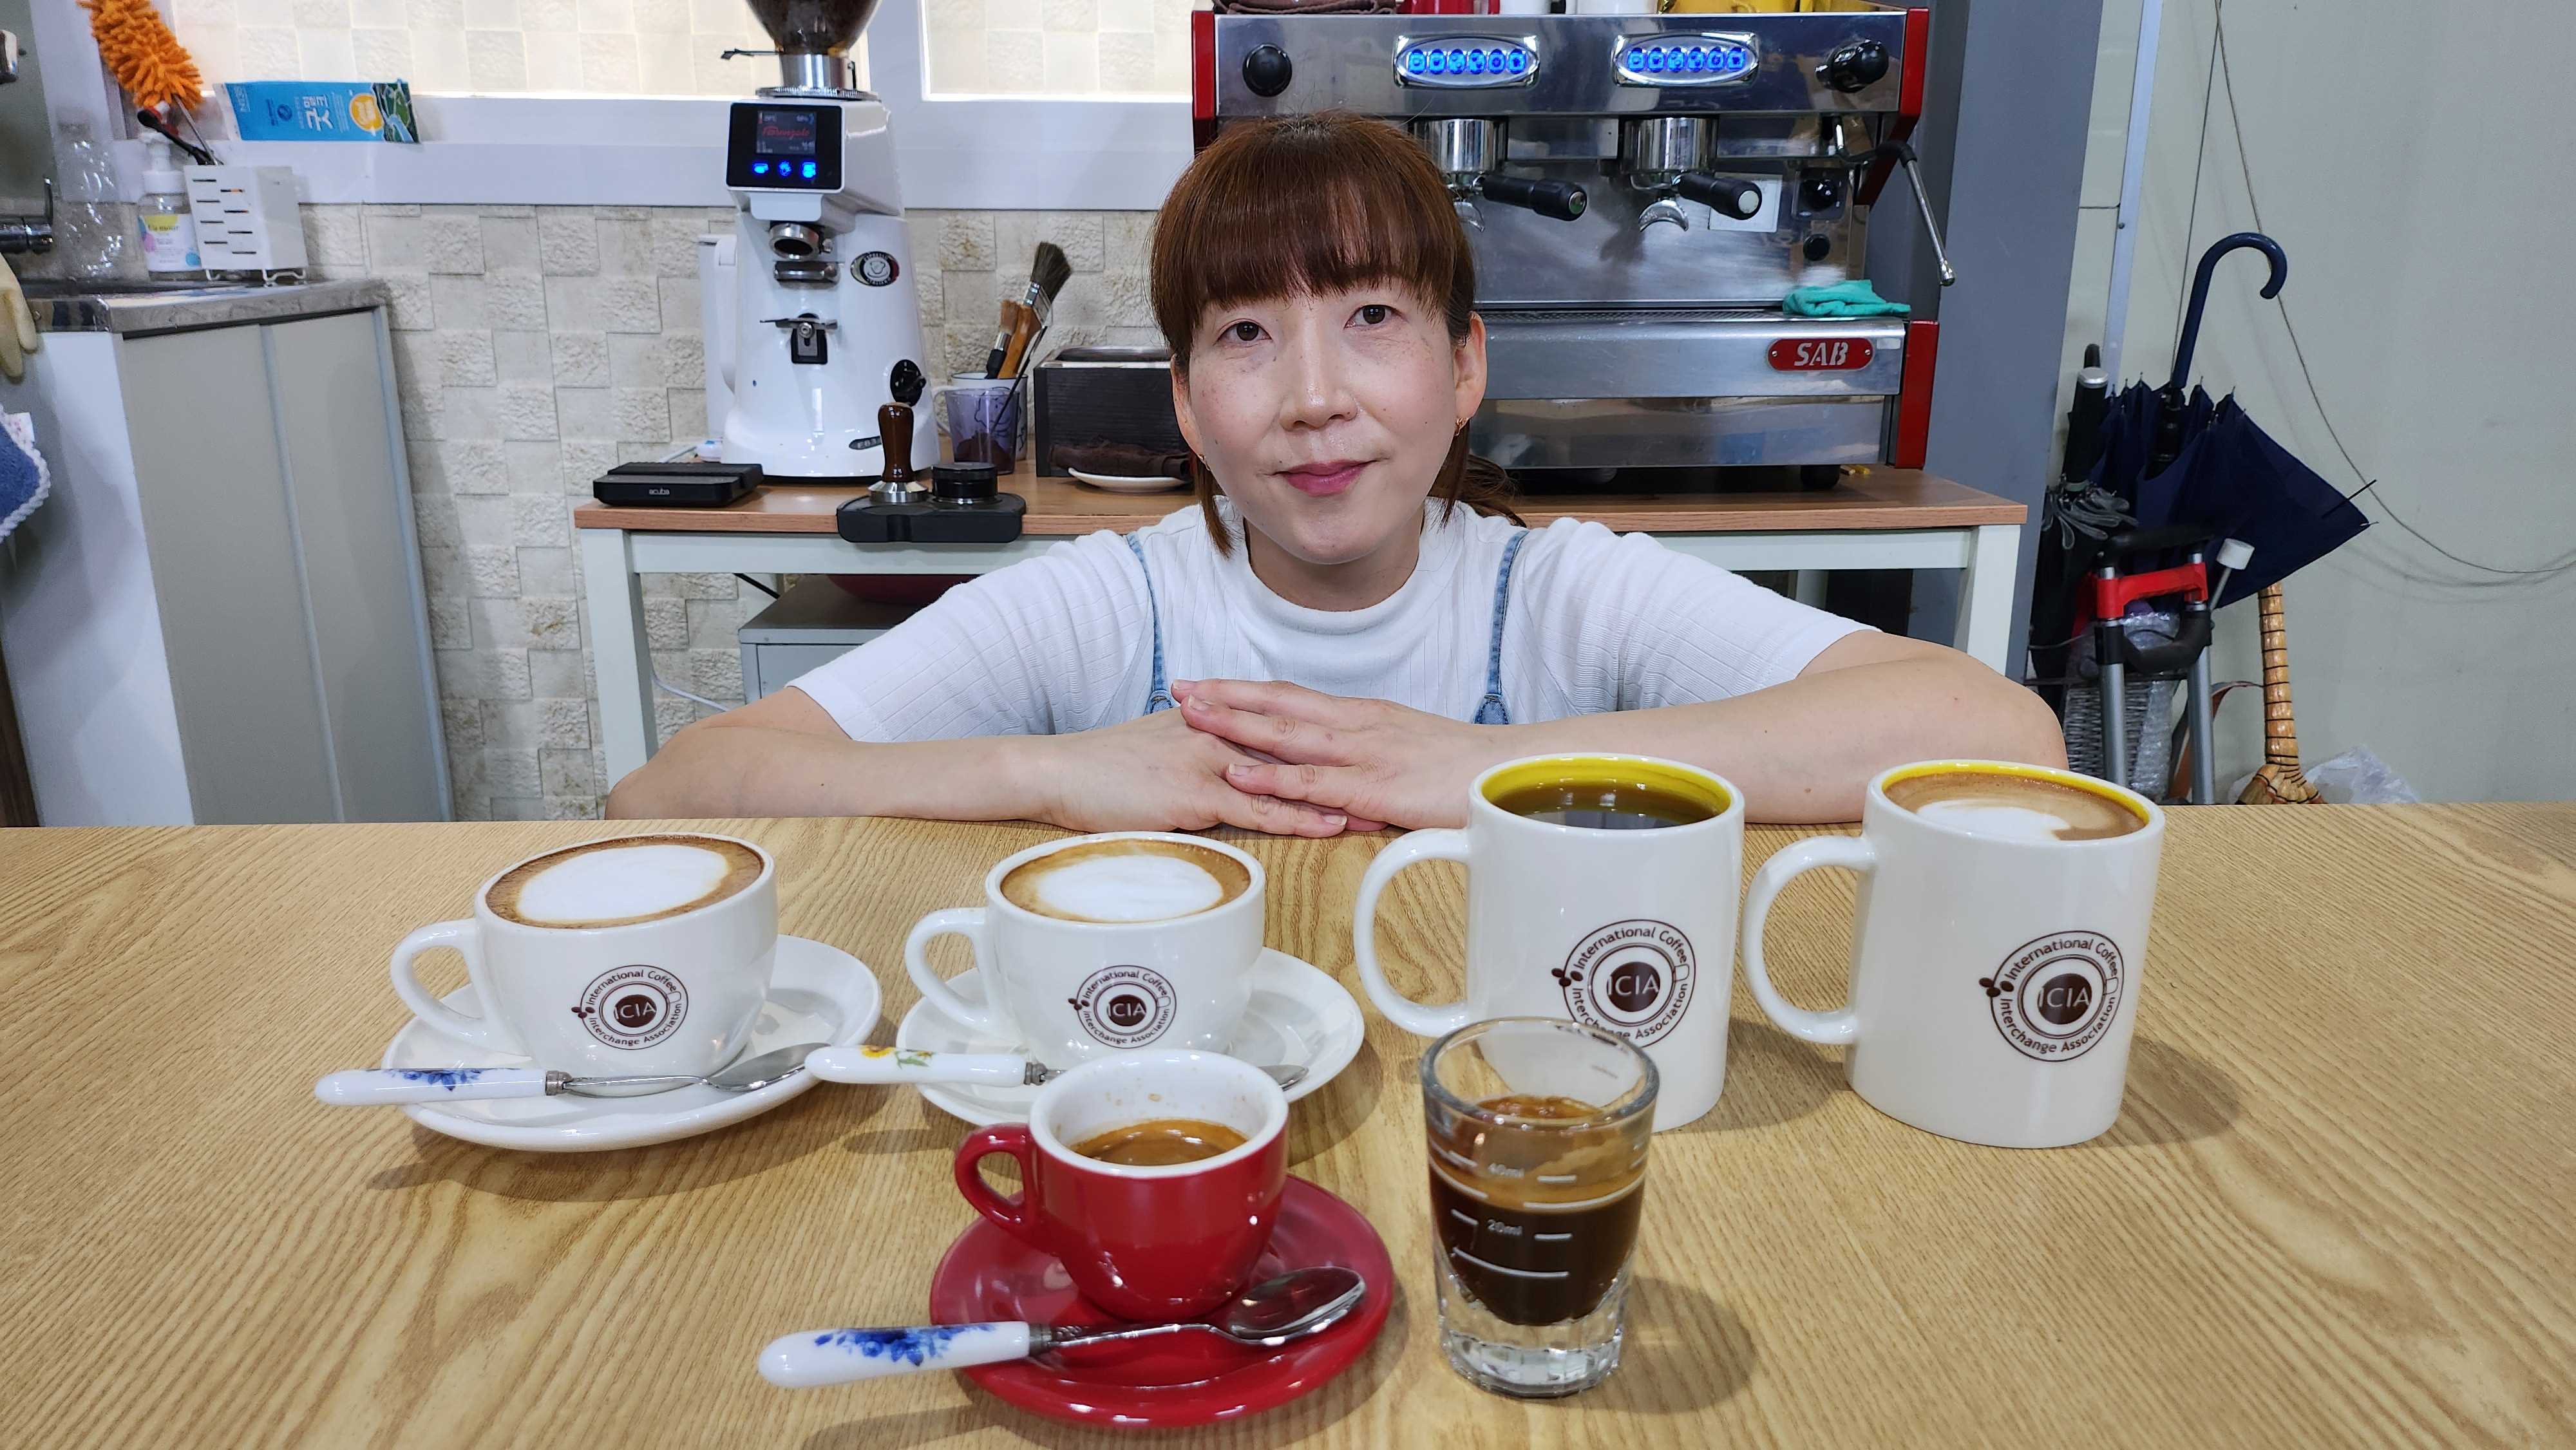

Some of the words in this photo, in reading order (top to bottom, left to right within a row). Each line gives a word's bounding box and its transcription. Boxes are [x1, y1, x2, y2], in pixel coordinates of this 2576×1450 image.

[1794, 341, 1848, 366] SAB
[1573, 927, 1656, 970] International
[1659, 930, 1687, 964] Coffee
[2004, 939, 2094, 981] International
[2096, 943, 2118, 977] Coffee
[585, 970, 644, 1005] International
[648, 970, 676, 992] Coffee
[1083, 970, 1139, 999] International
[1142, 974, 1168, 996] Coffee
[1606, 974, 1660, 995] ICIA
[2038, 986, 2090, 1008] ICIA
[589, 1018, 640, 1046] Interchange
[644, 1003, 682, 1042] Association
[614, 1002, 656, 1019] ICIA
[1083, 1011, 1127, 1044] Interchange
[1131, 1008, 1170, 1043] Association
[1107, 1003, 1146, 1017] ICIA
[1635, 983, 1688, 1040] Association
[2000, 998, 2057, 1054] Interchange
[2060, 997, 2116, 1053] Association
[1488, 1219, 1522, 1236] 20ml
